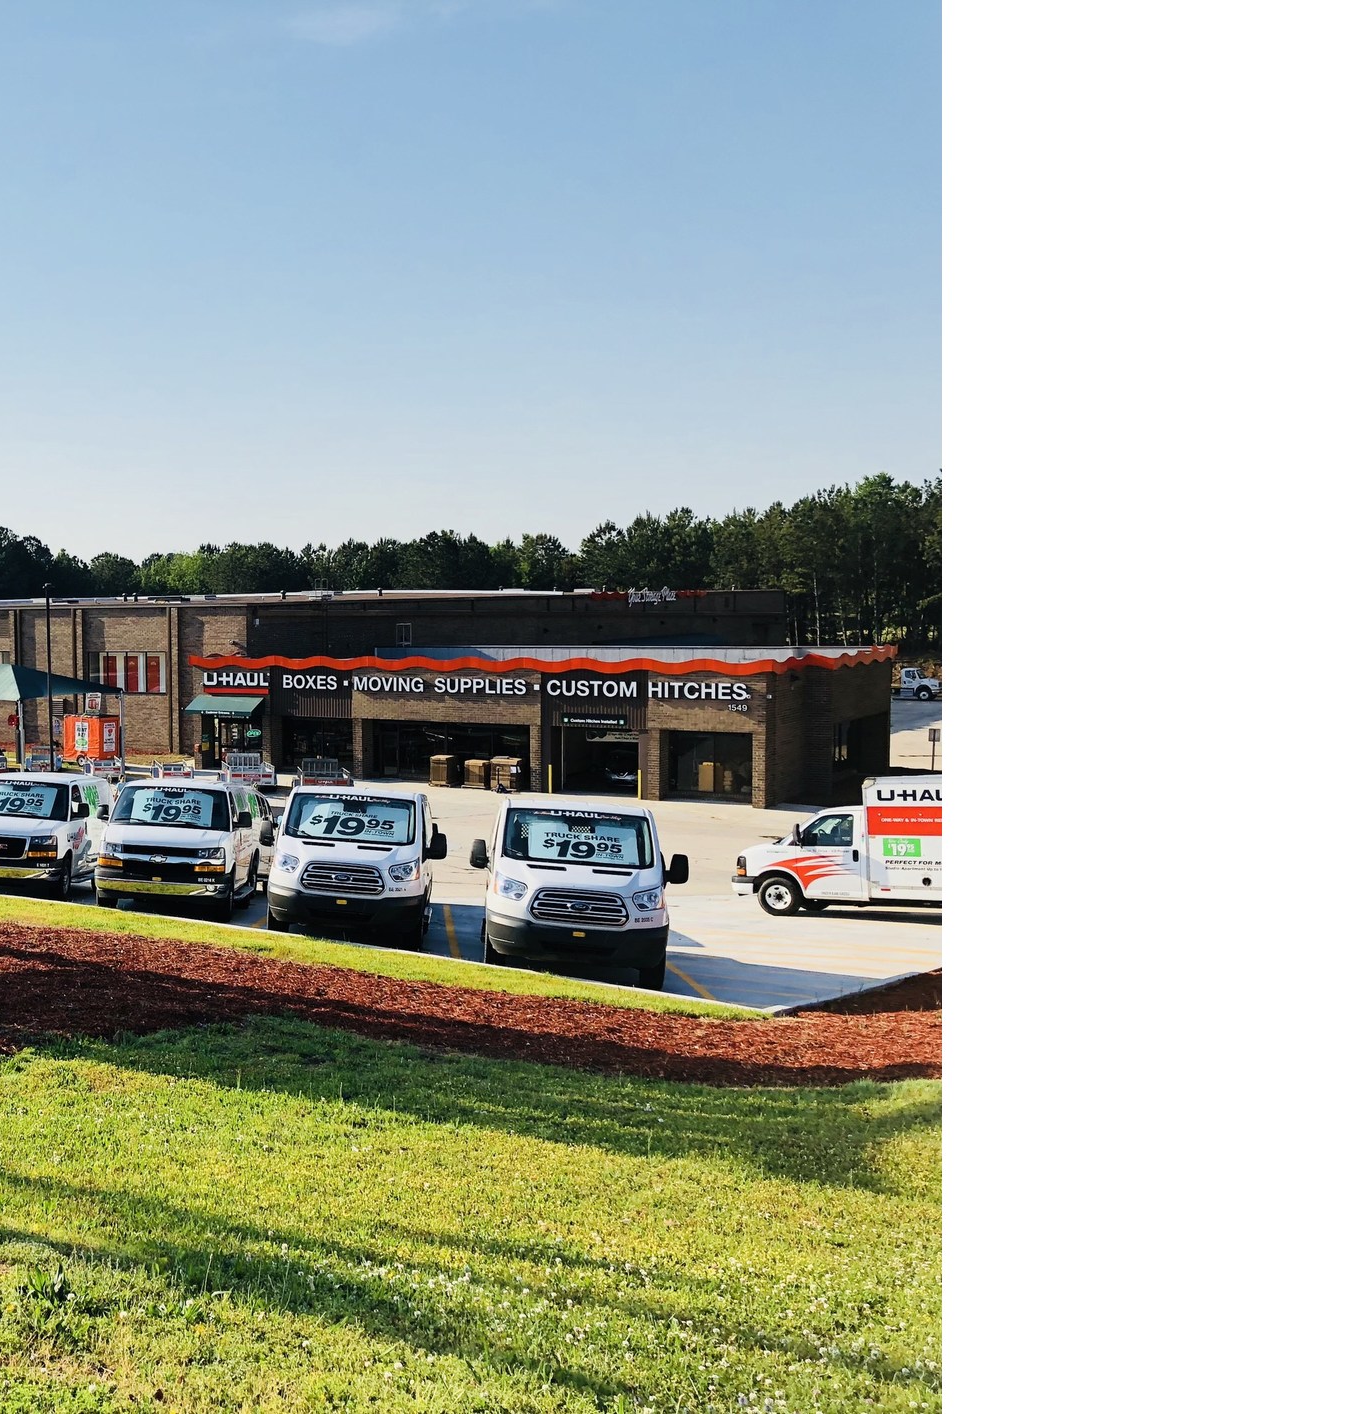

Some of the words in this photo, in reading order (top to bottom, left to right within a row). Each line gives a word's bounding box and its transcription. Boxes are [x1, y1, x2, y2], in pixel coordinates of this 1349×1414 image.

[203, 672, 269, 687] U-HAUL
[282, 674, 338, 690] BOXES
[352, 675, 424, 692] MOVING
[434, 677, 527, 695] SUPPLIES
[546, 679, 638, 698] CUSTOM
[648, 681, 748, 700] HITCHES
[727, 704, 748, 712] 1549
[329, 794, 374, 802] U-HAUL
[550, 810, 602, 819] U-HAUL
[544, 832, 581, 840] TRUCK
[584, 833, 621, 843] SHARE
